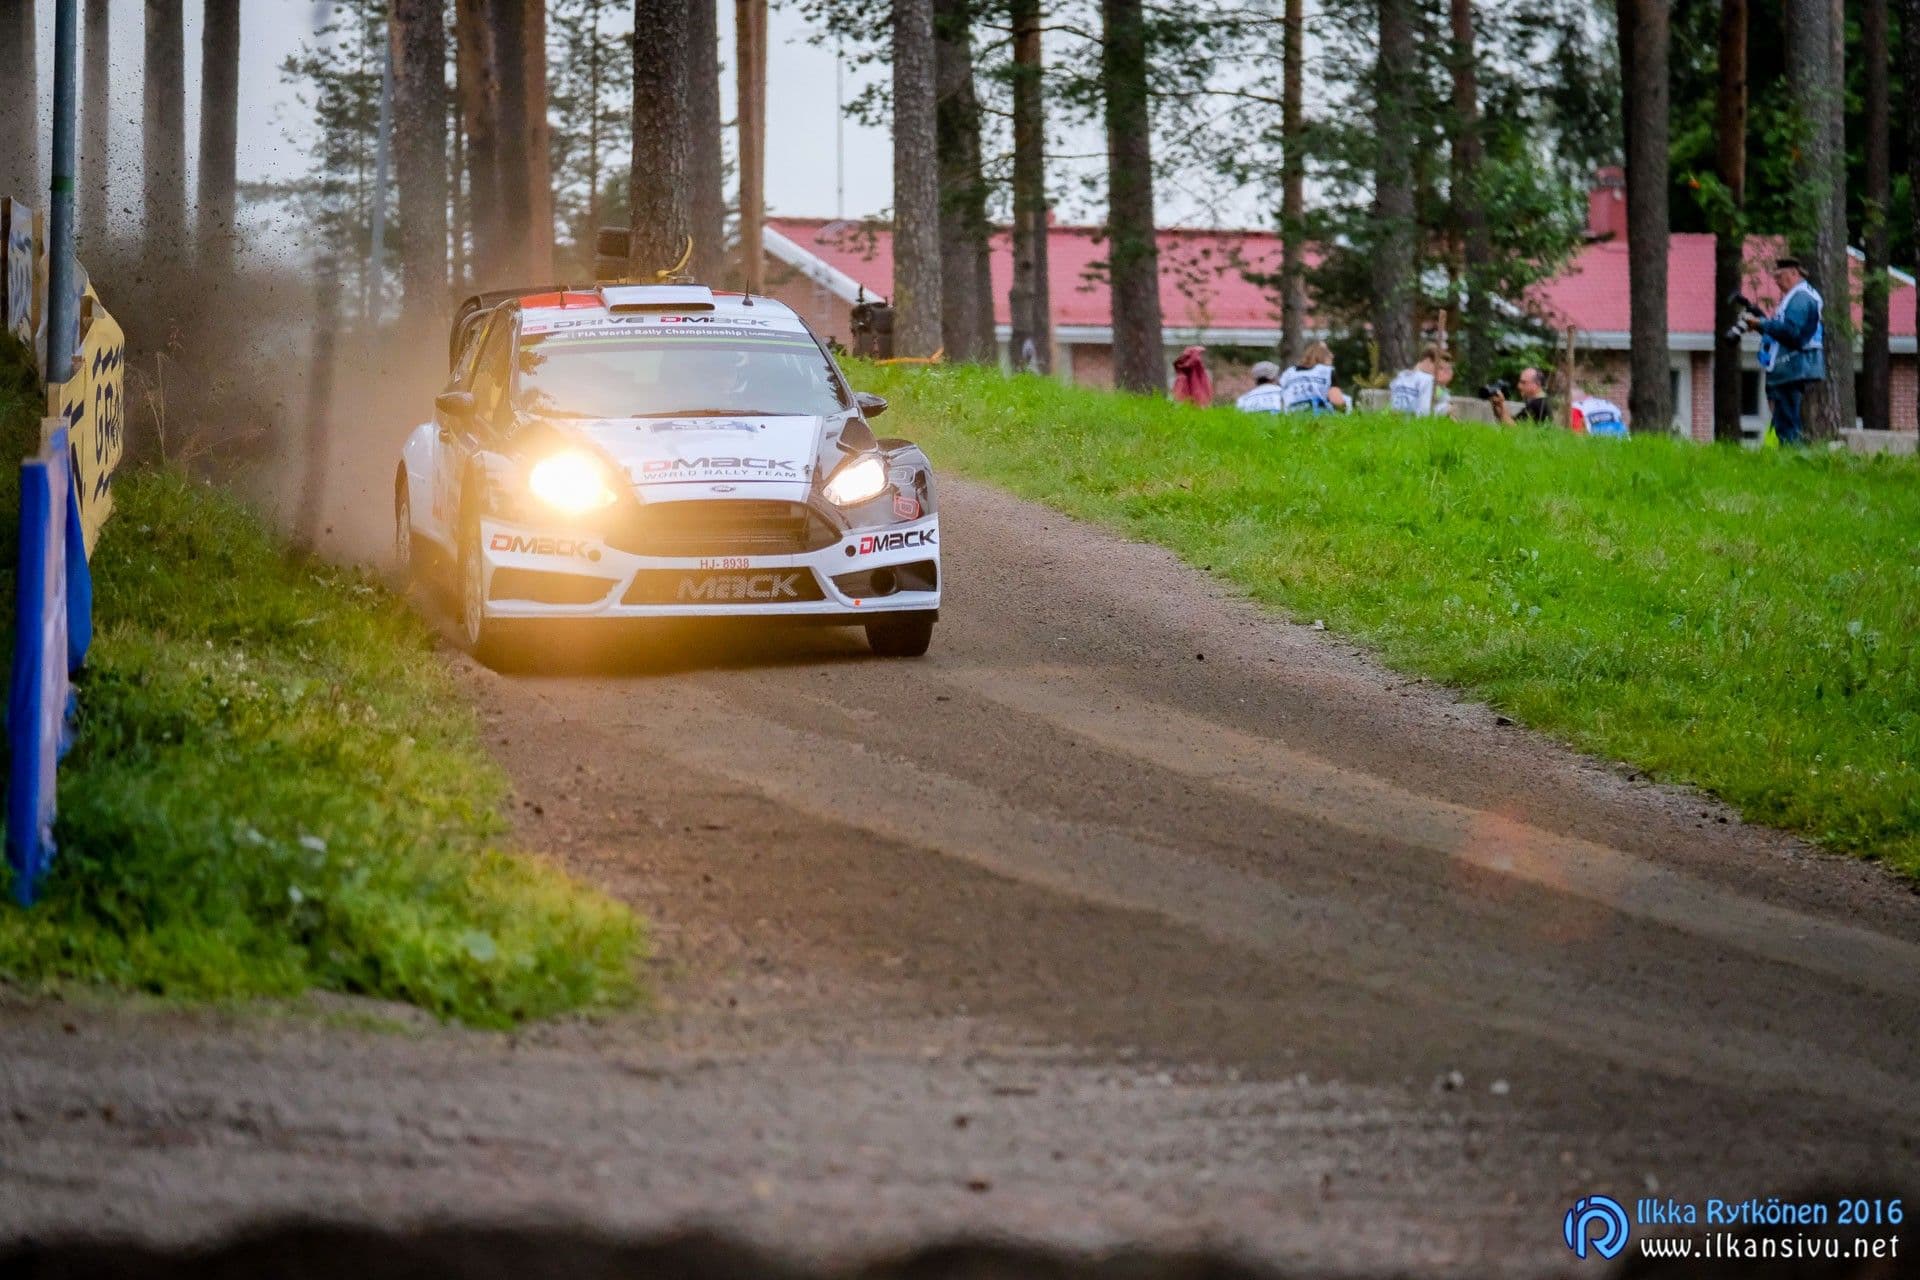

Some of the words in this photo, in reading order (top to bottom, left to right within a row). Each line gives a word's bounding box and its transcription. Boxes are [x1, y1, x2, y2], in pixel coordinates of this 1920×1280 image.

[553, 315, 645, 329] DRIVE
[600, 328, 631, 337] World
[635, 328, 661, 337] Rally
[665, 328, 742, 337] Championship
[643, 470, 697, 480] WORLD
[704, 469, 749, 477] RALLY
[757, 470, 797, 478] TEAM
